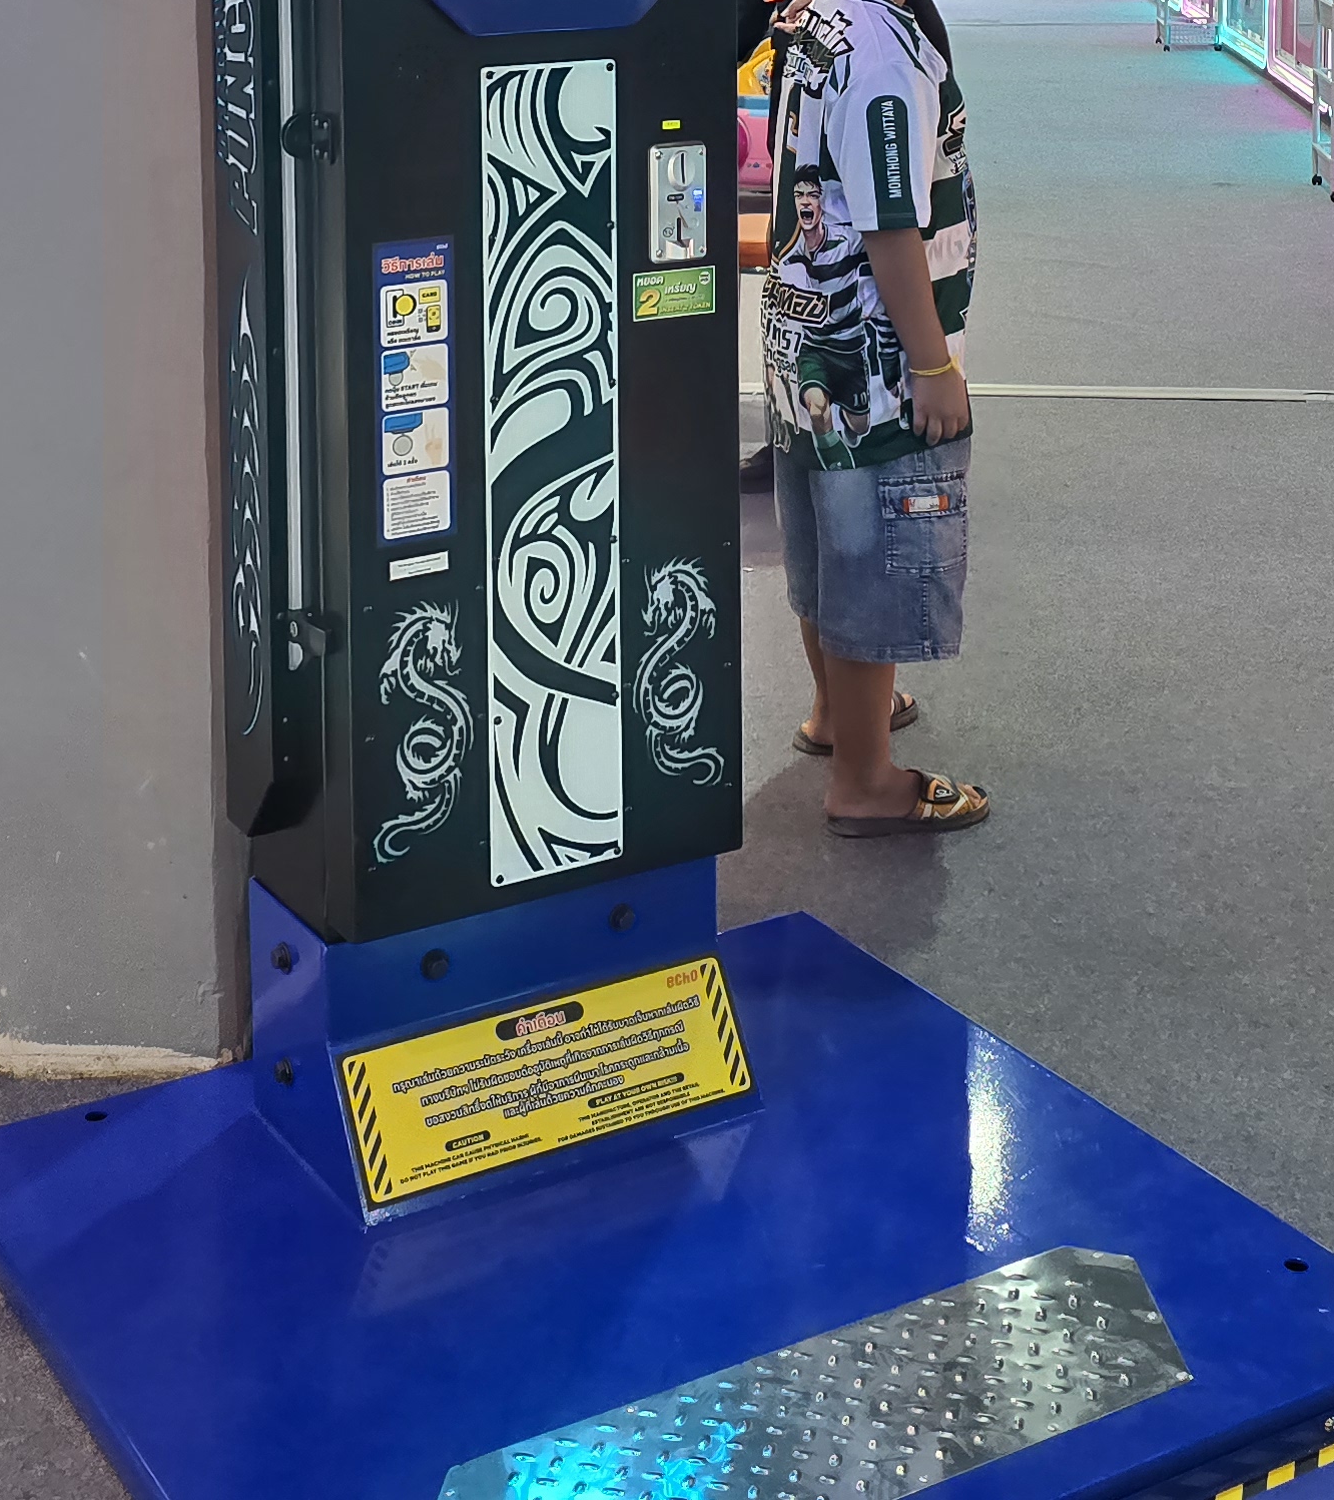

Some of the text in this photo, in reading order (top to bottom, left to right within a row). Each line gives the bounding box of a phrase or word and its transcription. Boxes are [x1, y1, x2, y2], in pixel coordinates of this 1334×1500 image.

[880, 100, 902, 198] MONTHONG WITTAYA
[381, 251, 444, 274] วิธีการเล่น
[637, 276, 664, 287] หยอด
[637, 281, 696, 316] 2 เหรียญ
[513, 1007, 567, 1036] คำเตือน
[594, 1095, 612, 1105] PLAY
[612, 1092, 622, 1100] AT
[622, 1086, 640, 1097] YOUR
[639, 1081, 657, 1092] OWN
[671, 1086, 682, 1094] THE
[557, 1135, 569, 1143] FOR
[569, 1127, 595, 1139] DAMAGES
[632, 1112, 644, 1120] YOU
[451, 1133, 485, 1148] CAUTION
[399, 1176, 409, 1184] DO
[409, 1173, 421, 1181] NOT
[422, 1168, 437, 1177] PLAY
[451, 1158, 468, 1168] GAME
[474, 1153, 486, 1161] YOU
[424, 1156, 451, 1168] MACHINE
